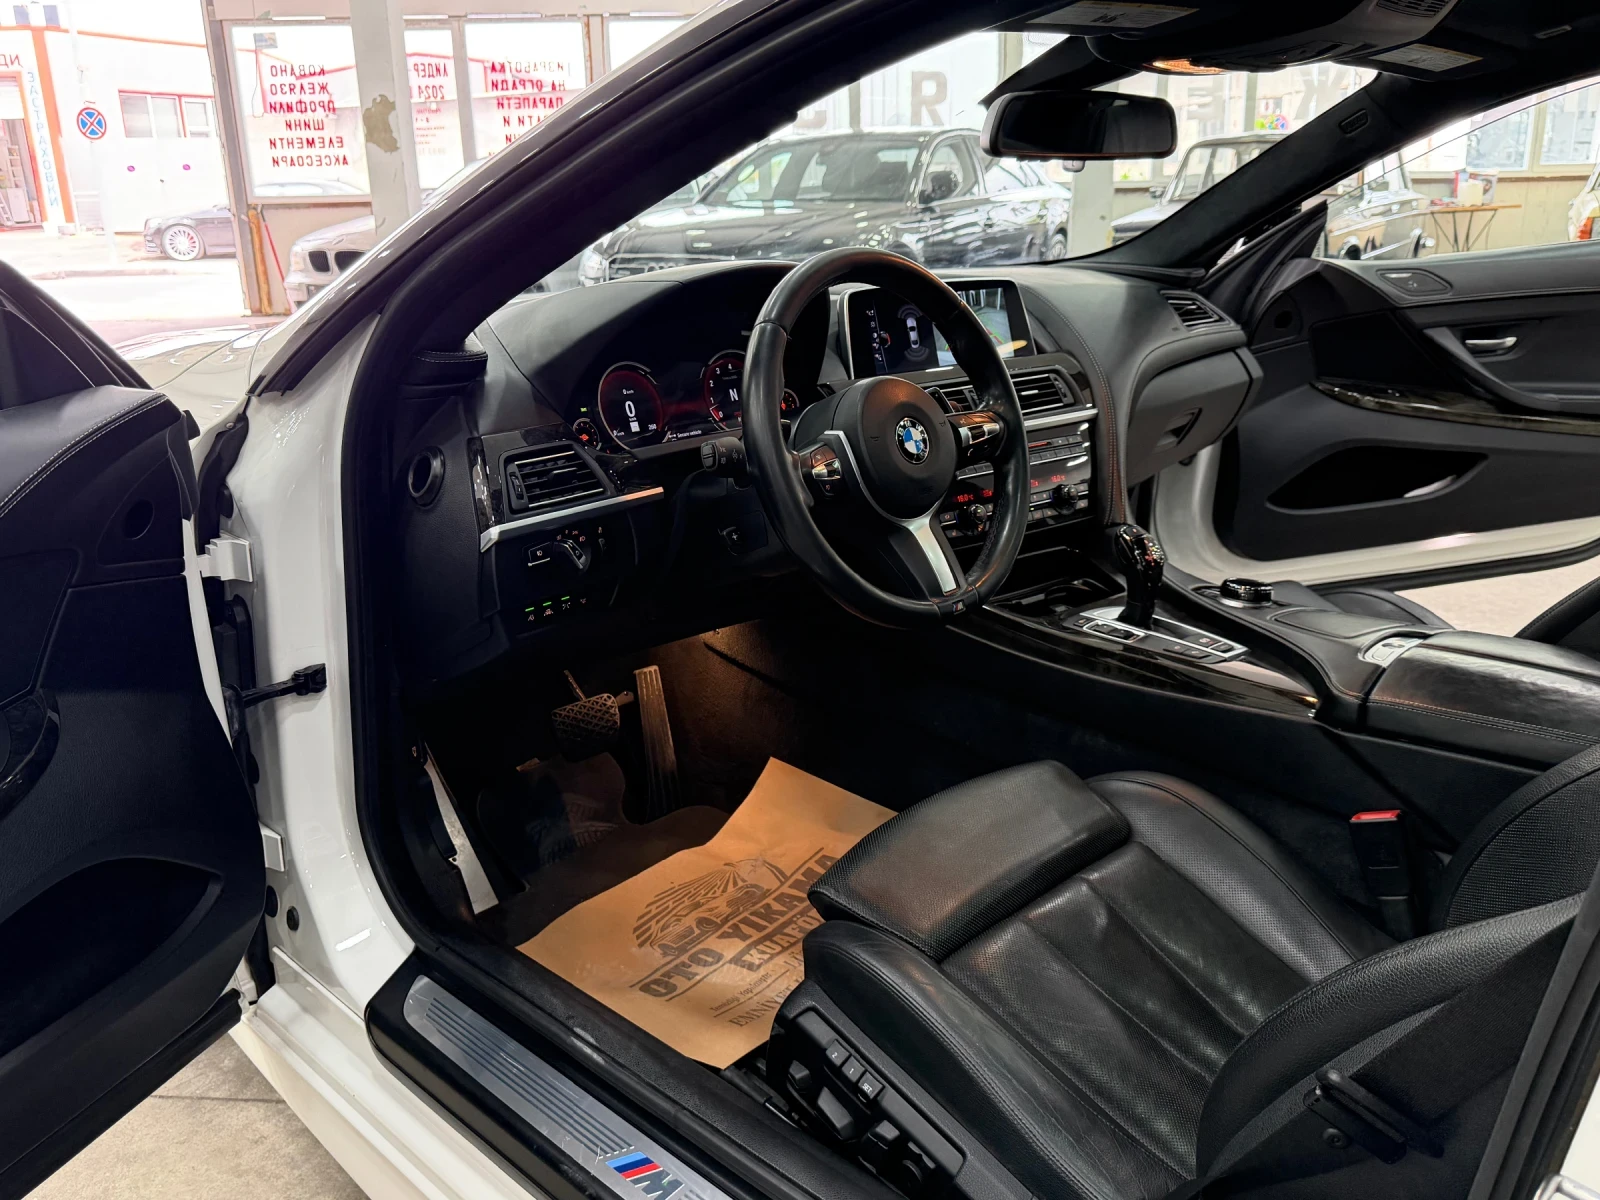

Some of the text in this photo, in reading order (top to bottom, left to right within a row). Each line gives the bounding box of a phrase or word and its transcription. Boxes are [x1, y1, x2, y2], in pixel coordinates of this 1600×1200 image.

[27, 71, 59, 206] ЗАСТРАХОВКИ
[625, 401, 635, 417] 0
[729, 388, 738, 401] N
[741, 912, 826, 965] KUAFÖ
[638, 947, 725, 997] OTO
[862, 1082, 873, 1093] SET
